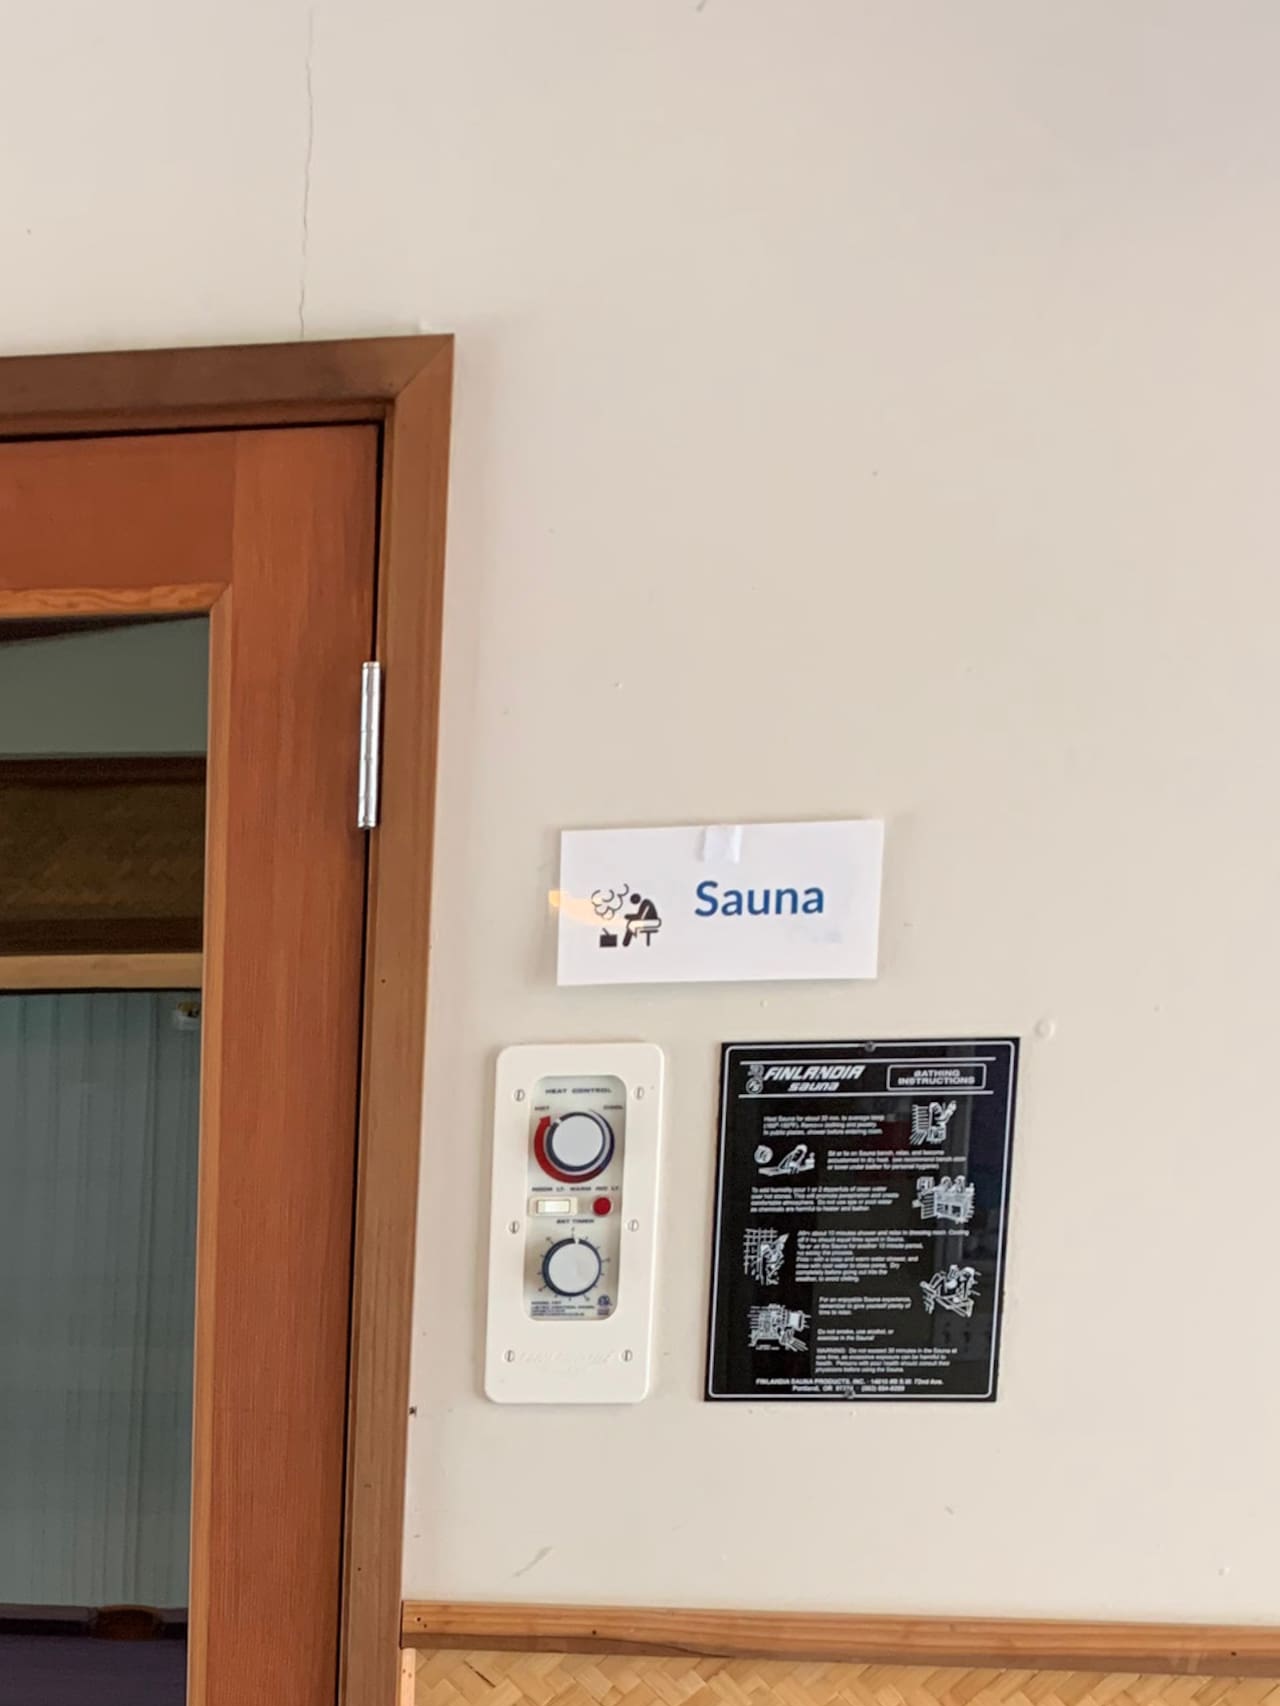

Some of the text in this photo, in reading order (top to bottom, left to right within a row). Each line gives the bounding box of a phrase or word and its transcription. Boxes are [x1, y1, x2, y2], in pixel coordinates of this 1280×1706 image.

[694, 880, 824, 917] Sauna
[764, 1064, 866, 1081] FINLANDIA
[913, 1069, 961, 1078] BATHING
[897, 1076, 976, 1085] INSTRUCTIONS
